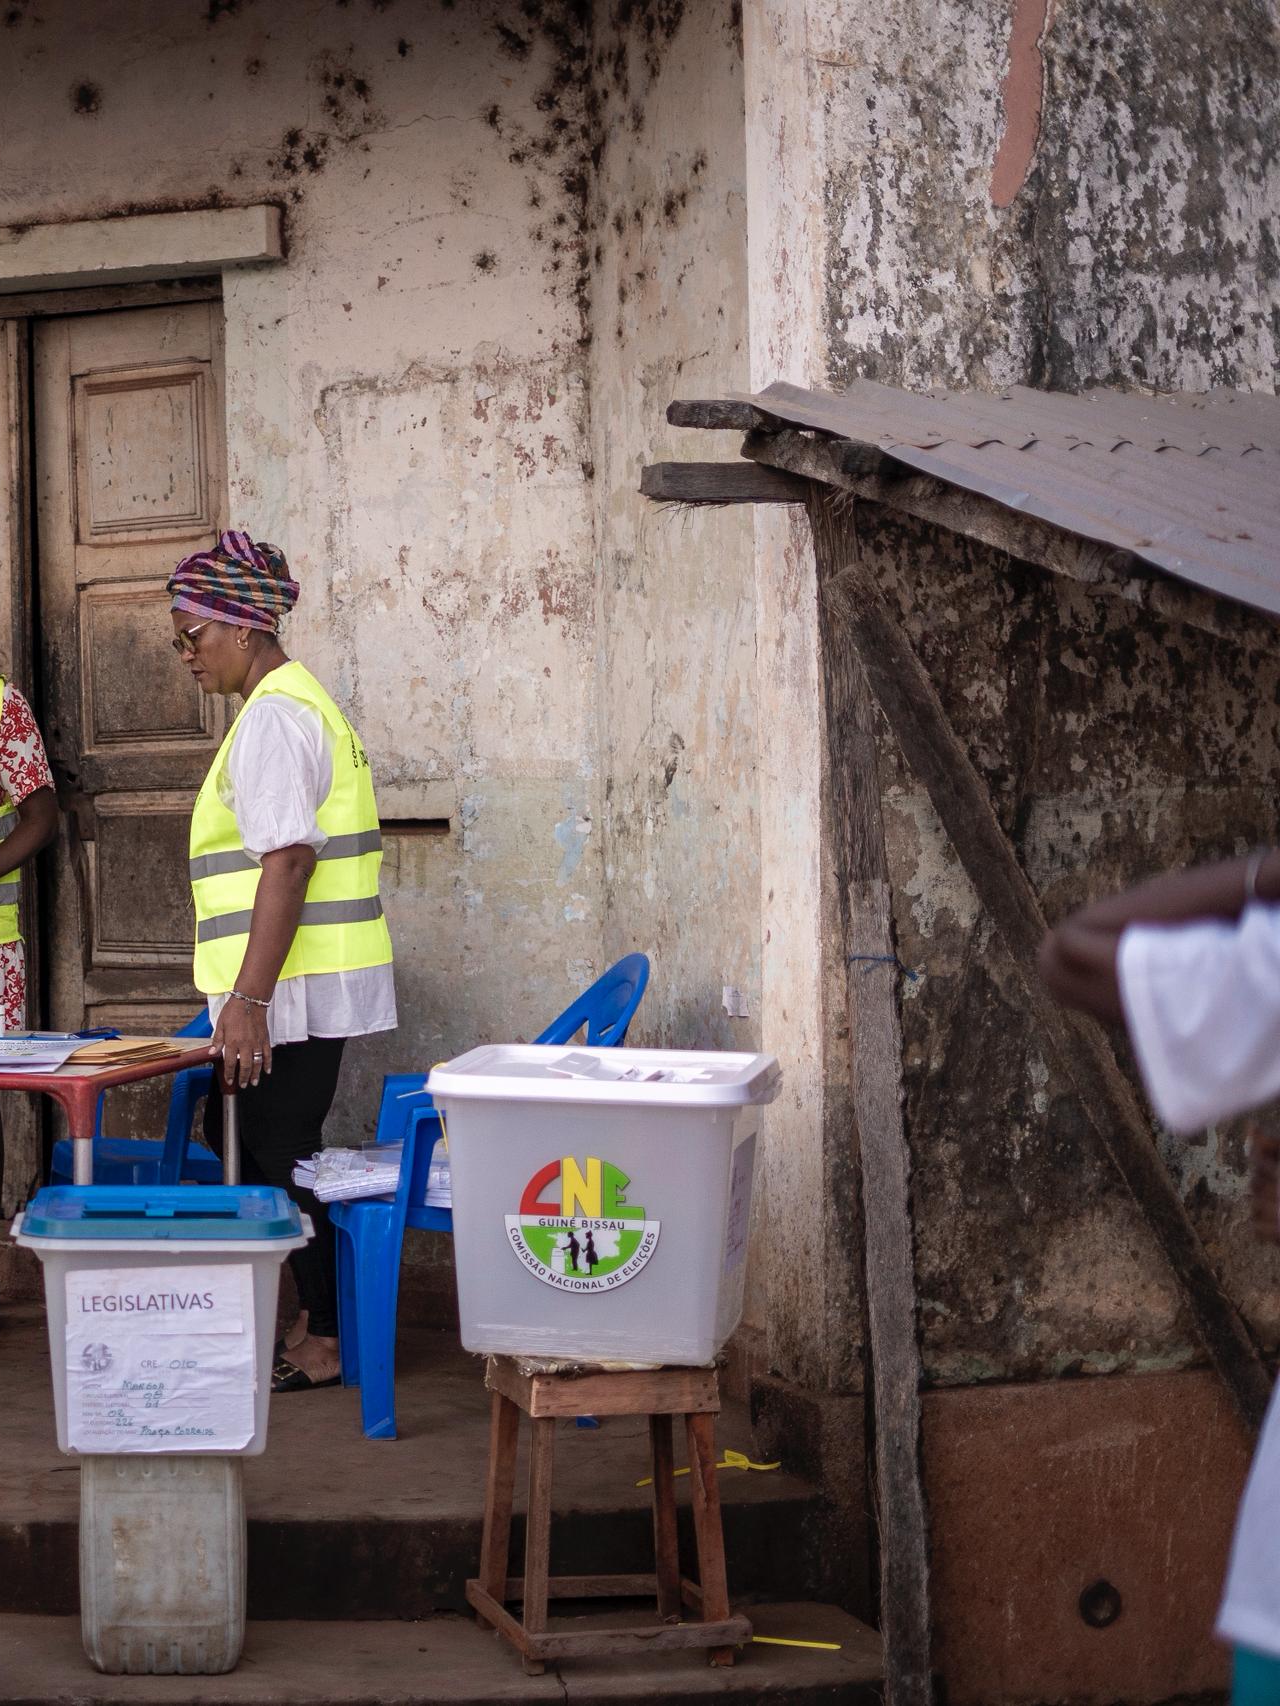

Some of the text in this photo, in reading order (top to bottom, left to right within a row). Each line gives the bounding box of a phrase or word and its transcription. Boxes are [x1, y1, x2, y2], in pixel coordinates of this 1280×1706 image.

[520, 1156, 646, 1220] CNE
[538, 1218, 625, 1230] GUINÉ BISSAU
[510, 1227, 656, 1290] COMISSÃO NACIONAL DE ELEIÇÕES
[81, 1292, 214, 1313] LEGISLATIVAS
